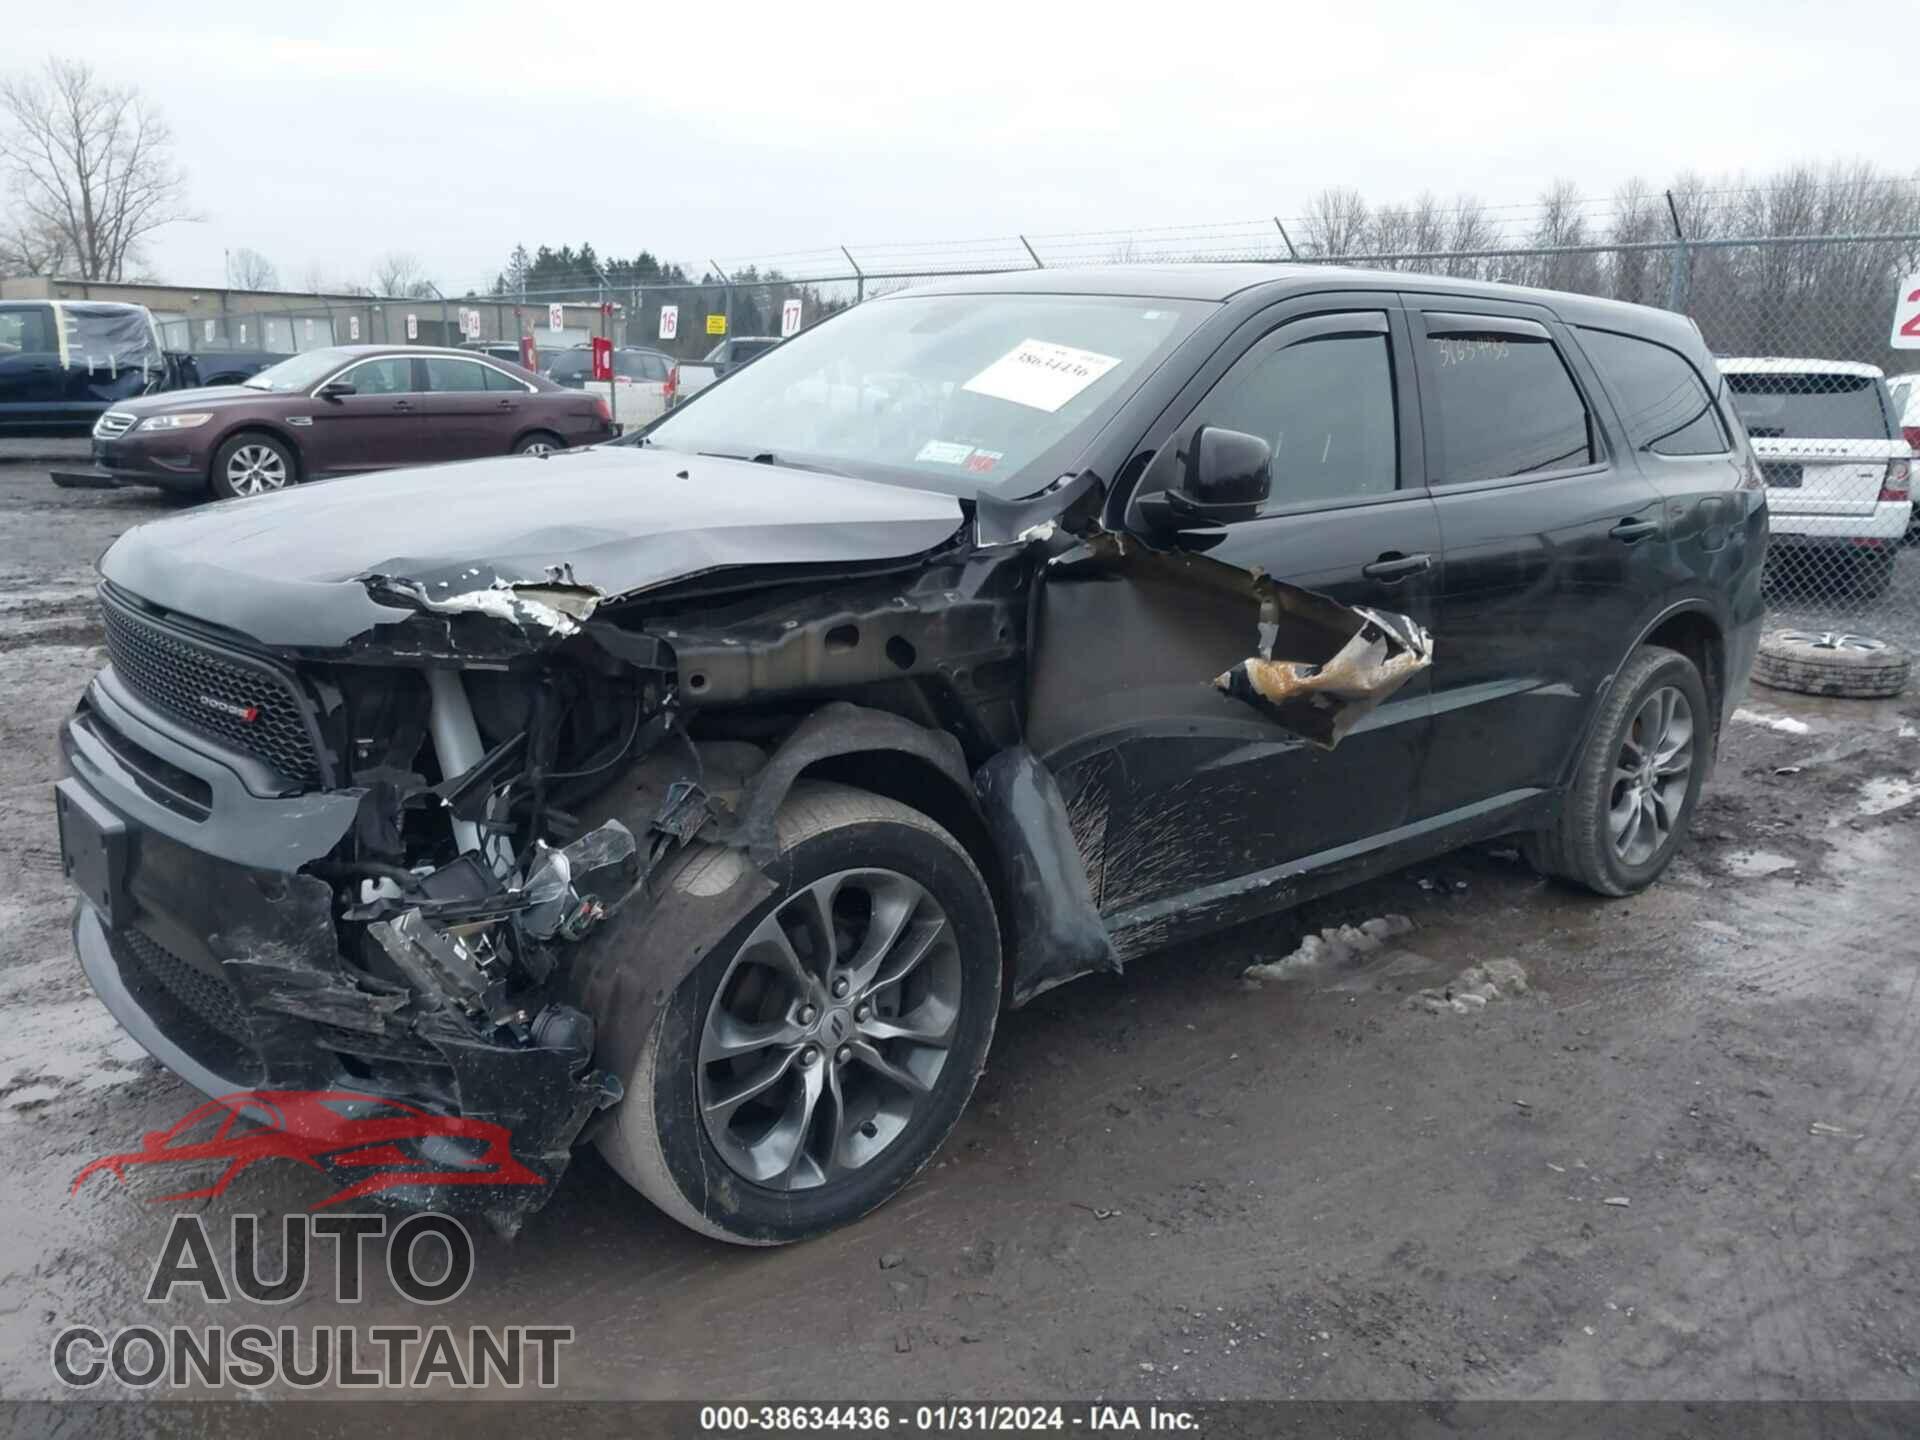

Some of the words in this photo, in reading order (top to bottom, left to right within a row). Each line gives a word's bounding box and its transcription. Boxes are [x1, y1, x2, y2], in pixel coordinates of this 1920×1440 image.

[551, 308, 562, 329] 15
[661, 311, 675, 333] 16
[784, 307, 800, 330] 17
[199, 695, 248, 718] DODGE
